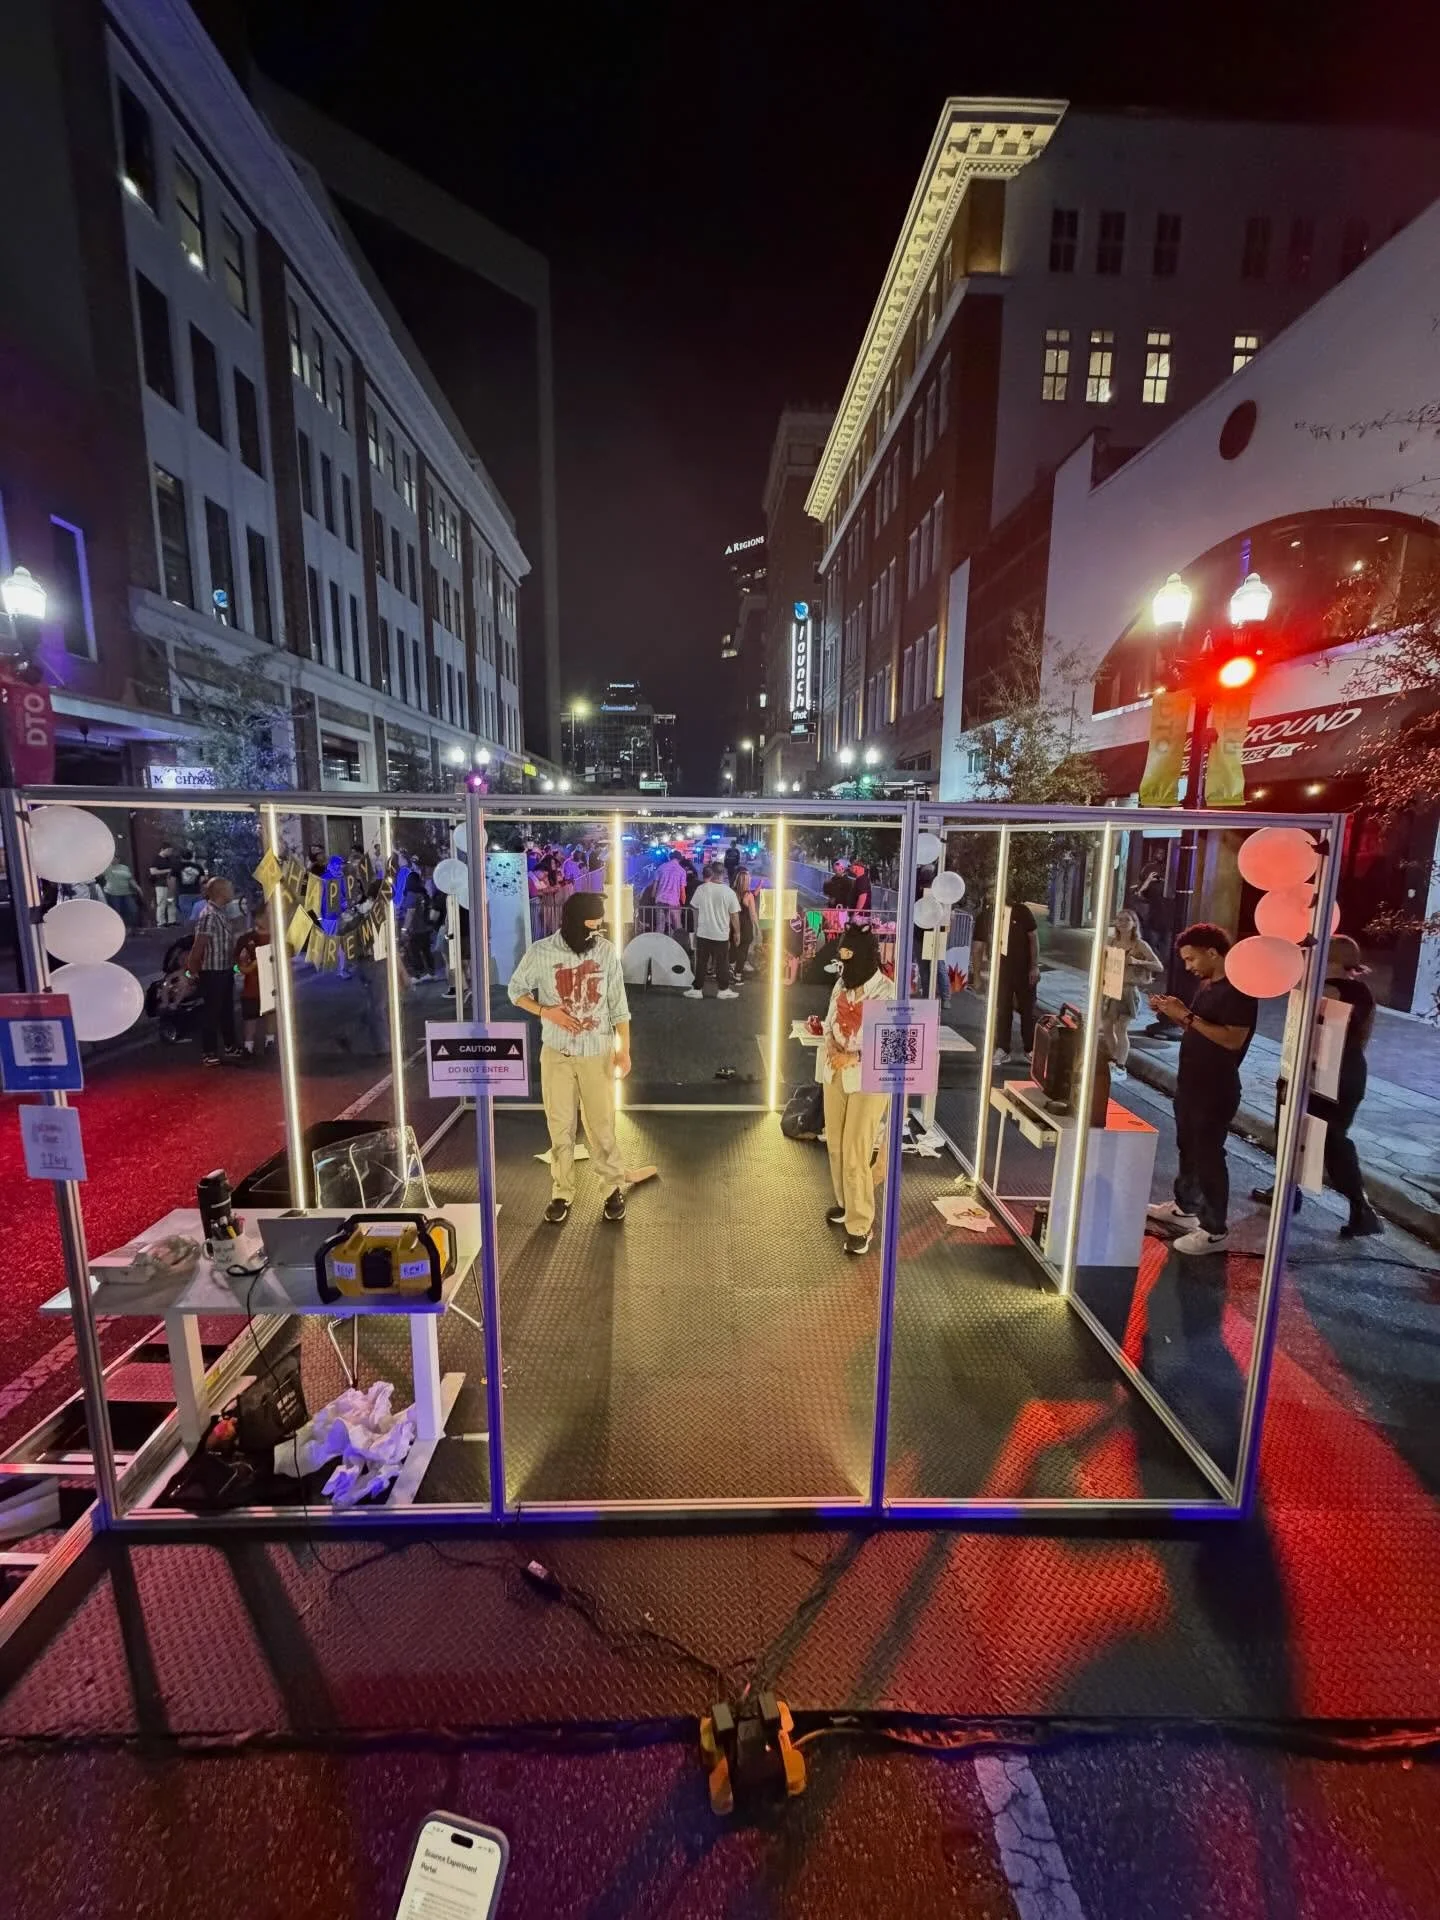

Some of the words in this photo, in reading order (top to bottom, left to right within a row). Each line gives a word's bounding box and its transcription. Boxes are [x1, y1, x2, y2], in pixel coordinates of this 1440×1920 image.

[733, 536, 765, 552] REGIONS
[796, 625, 807, 708] launch
[24, 693, 48, 746] DTO
[287, 860, 371, 907] HAPPY
[459, 1045, 497, 1053] CAUTION
